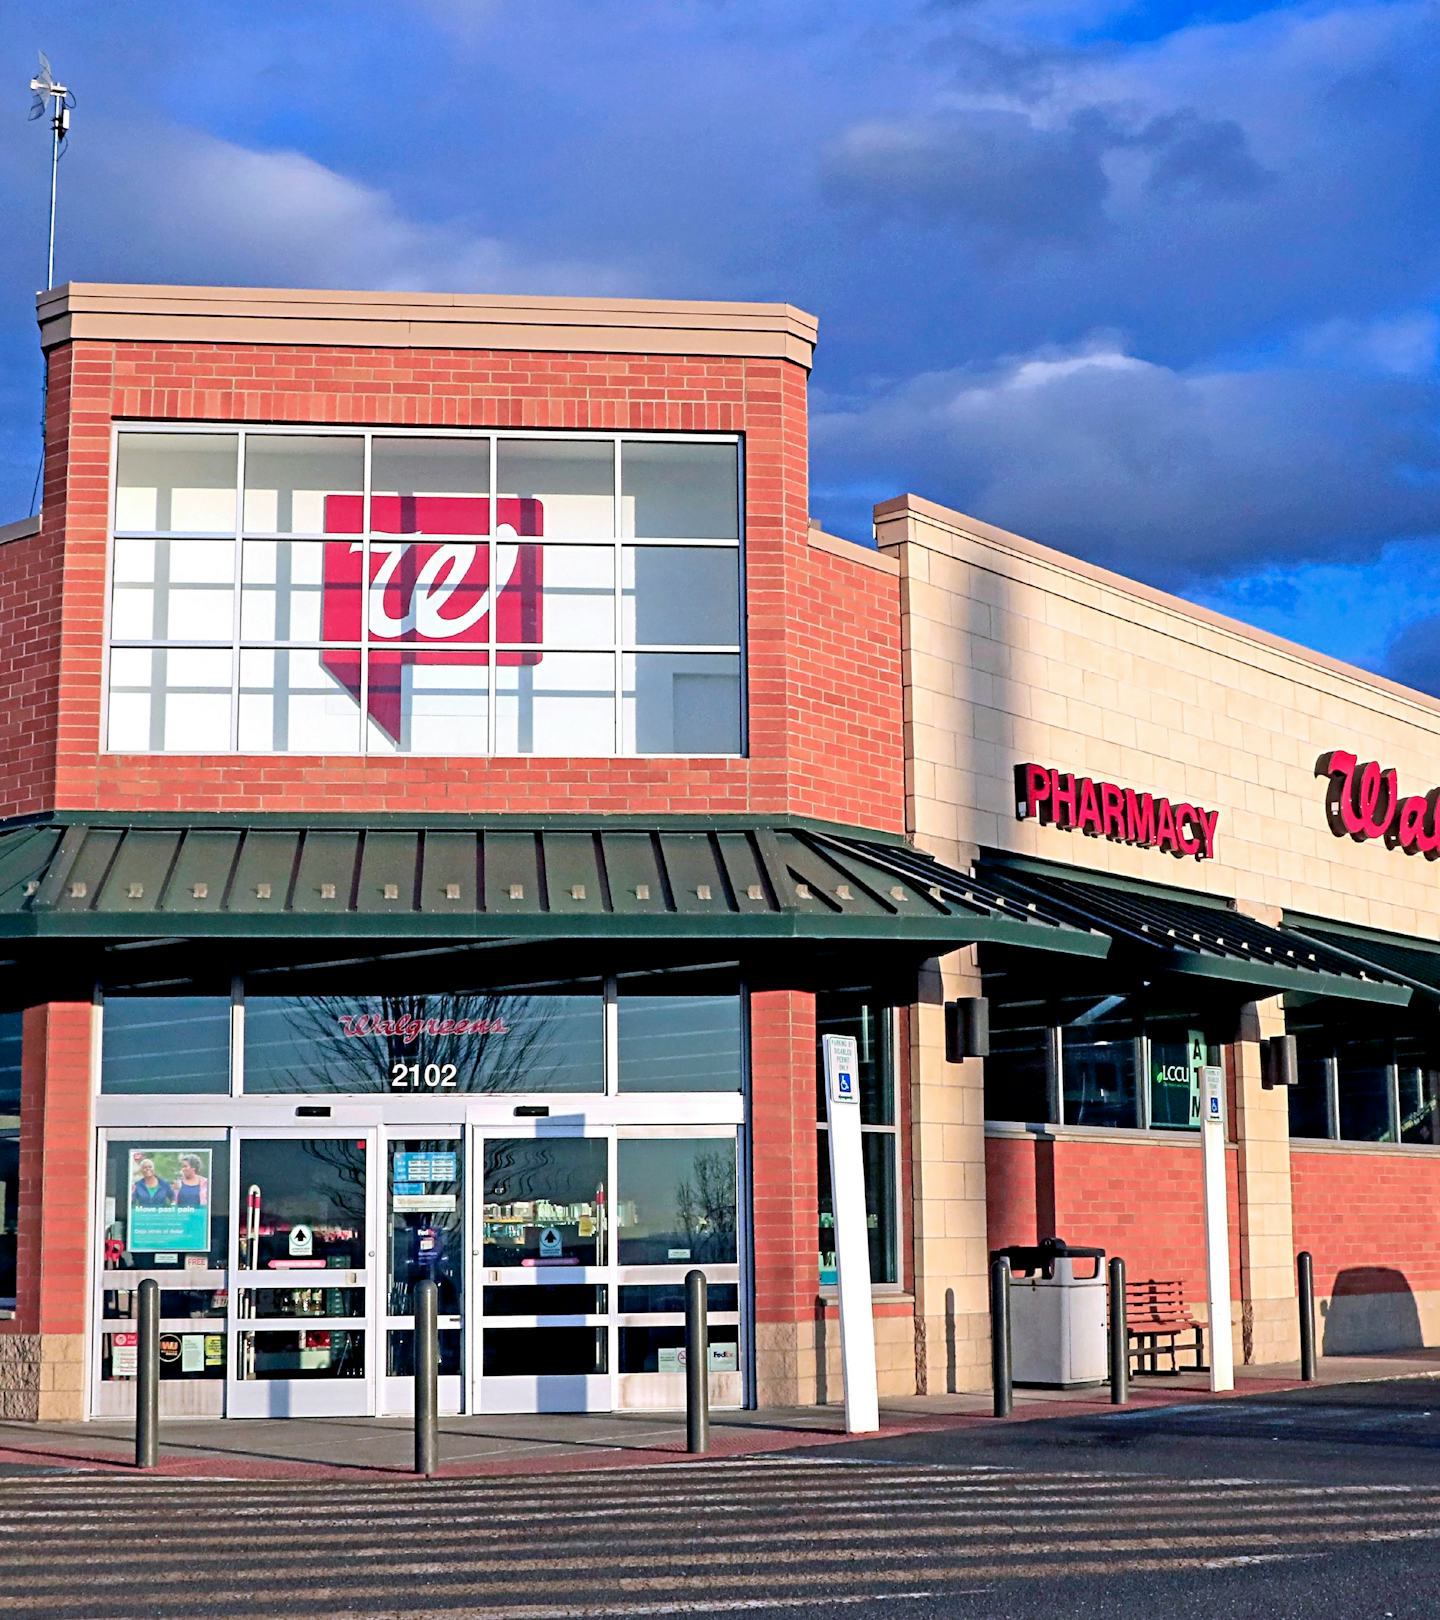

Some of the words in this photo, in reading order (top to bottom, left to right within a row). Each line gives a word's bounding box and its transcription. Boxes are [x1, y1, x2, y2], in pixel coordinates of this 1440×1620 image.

[1014, 763, 1219, 860] PHARMACY
[338, 1013, 509, 1044] Walgreens
[391, 1064, 457, 1087] 2102
[1162, 1065, 1189, 1083] LCCU
[158, 1206, 176, 1214] past
[178, 1206, 195, 1214] pain
[417, 1229, 436, 1237] Fed
[188, 1258, 206, 1266] FREE
